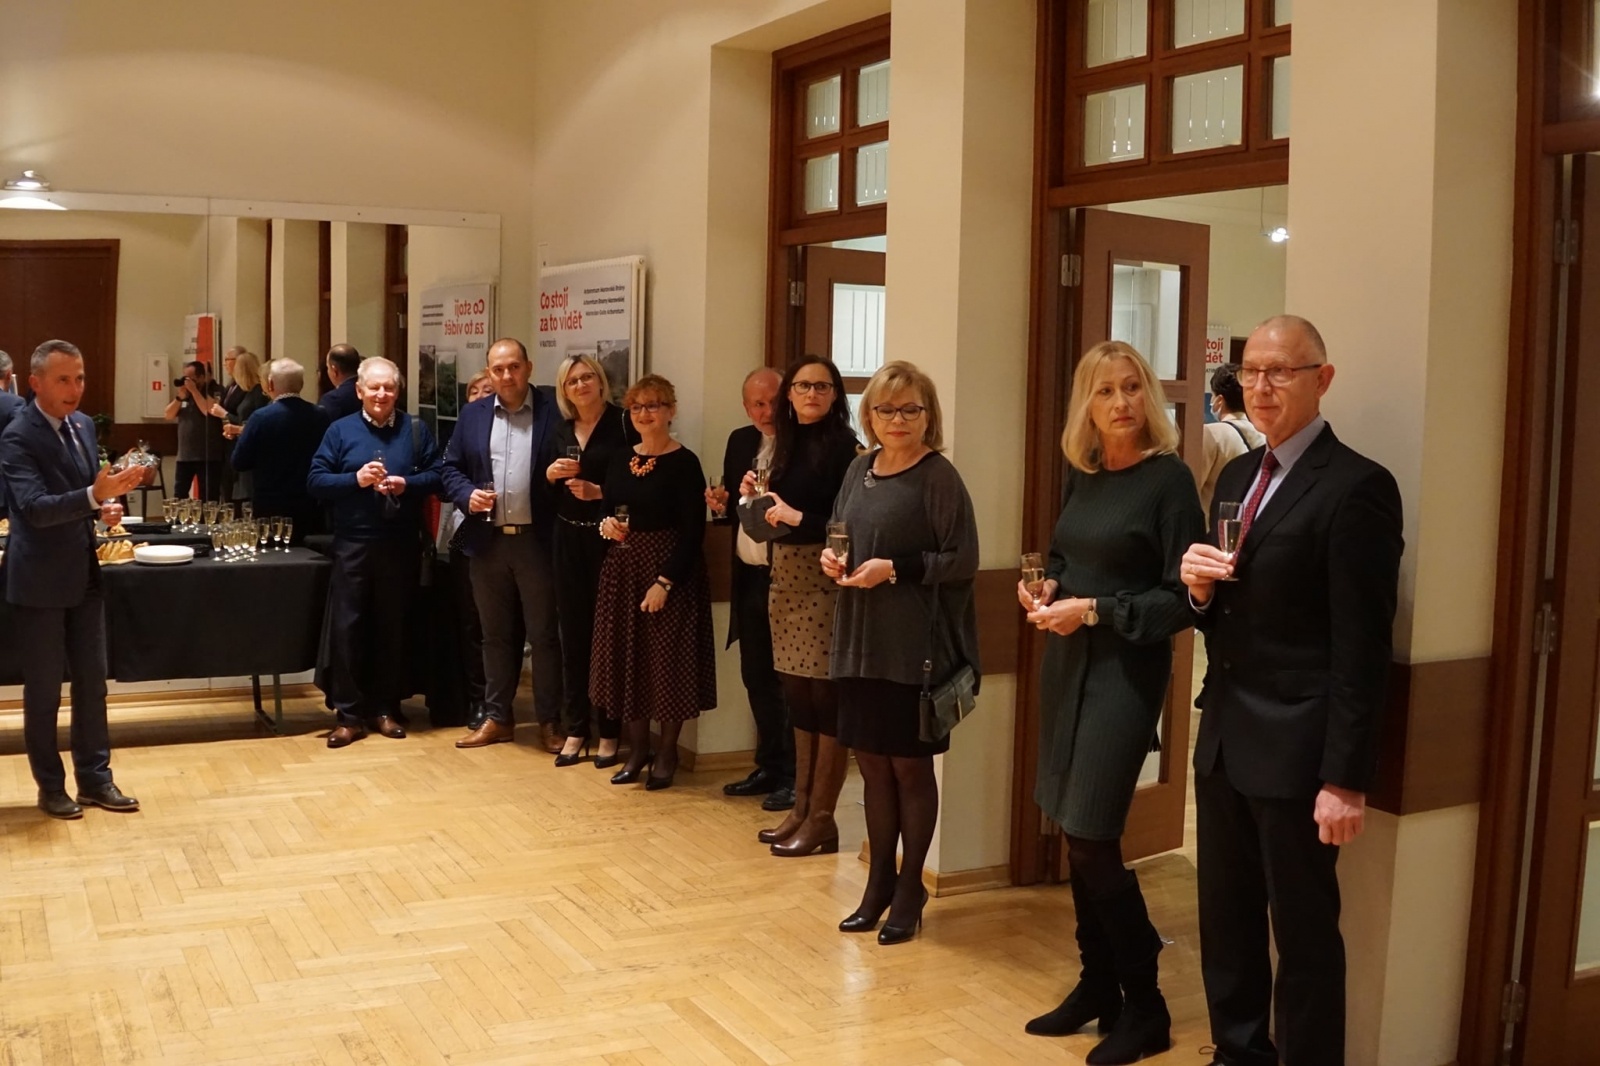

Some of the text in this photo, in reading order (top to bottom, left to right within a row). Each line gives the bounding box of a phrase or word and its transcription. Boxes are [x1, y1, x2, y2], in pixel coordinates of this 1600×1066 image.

[540, 286, 569, 310] Co stojí
[540, 310, 583, 331] za to vidět
[1206, 337, 1224, 351] tojí
[1205, 351, 1223, 363] dět
